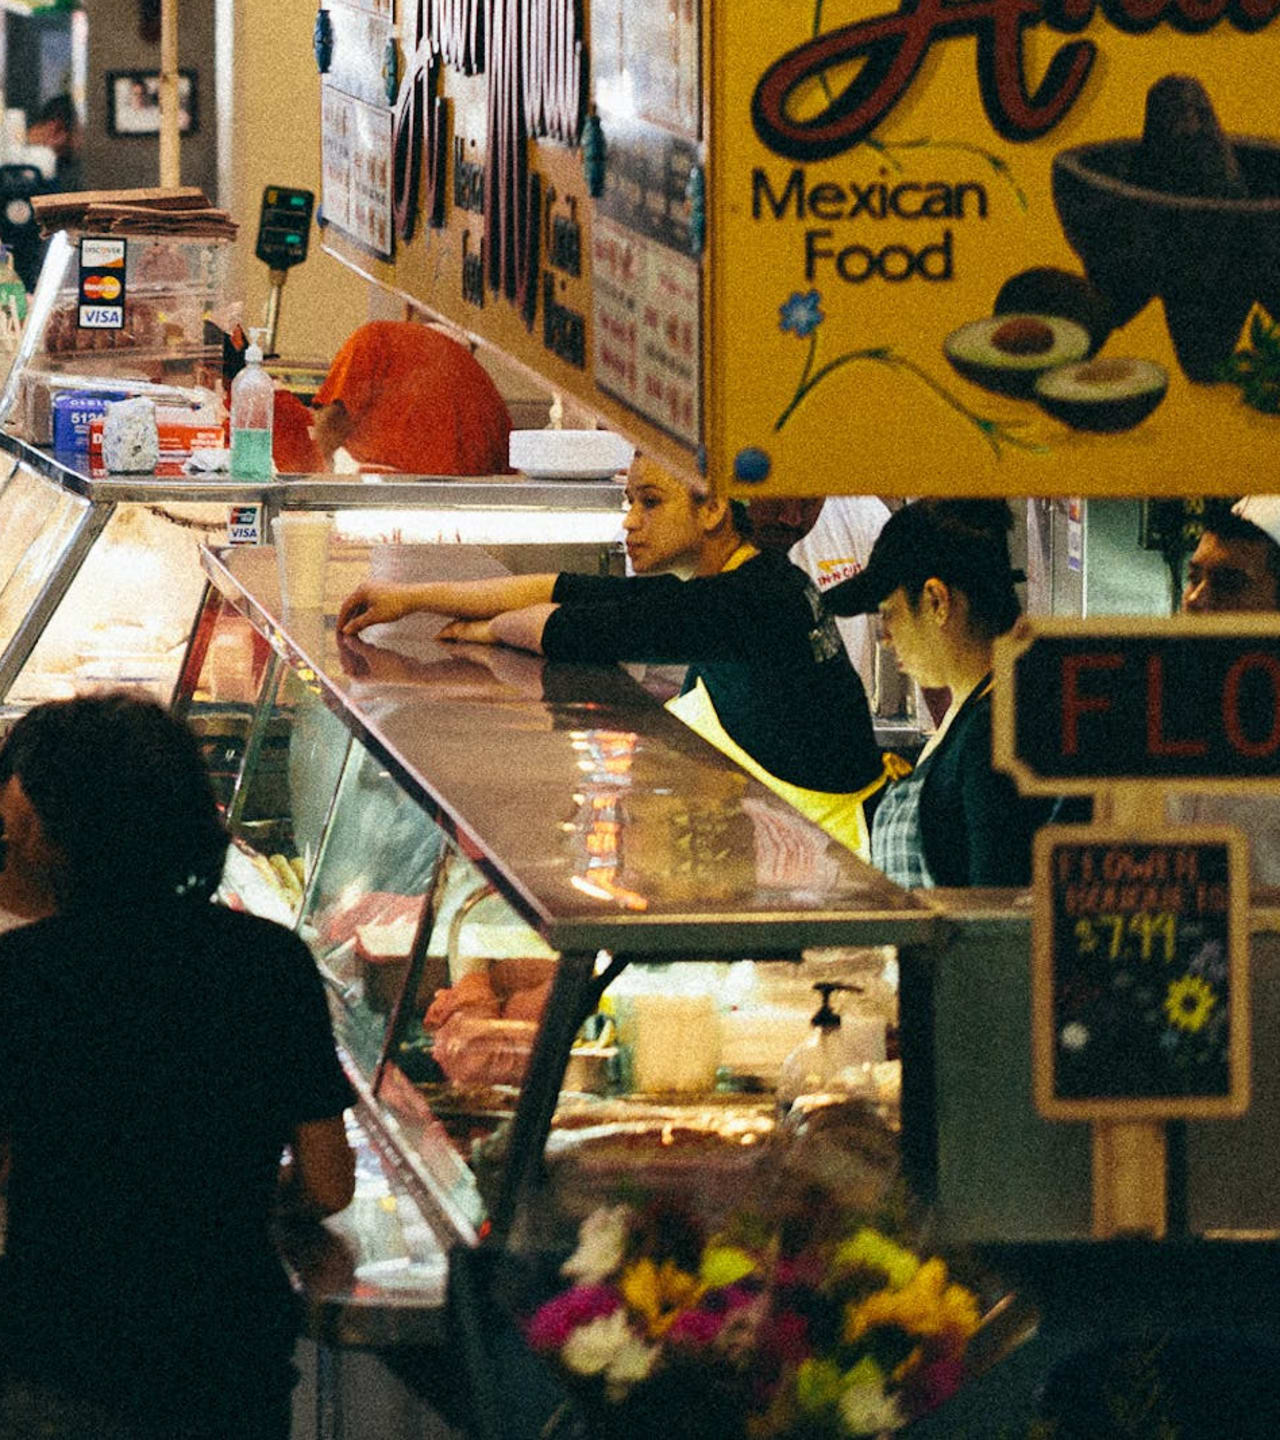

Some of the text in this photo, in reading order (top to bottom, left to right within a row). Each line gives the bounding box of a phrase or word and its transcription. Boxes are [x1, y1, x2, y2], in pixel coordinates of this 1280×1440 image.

[751, 170, 988, 223] Mexican
[806, 231, 954, 284] Food
[85, 310, 120, 324] VISA
[231, 528, 258, 539] VISA
